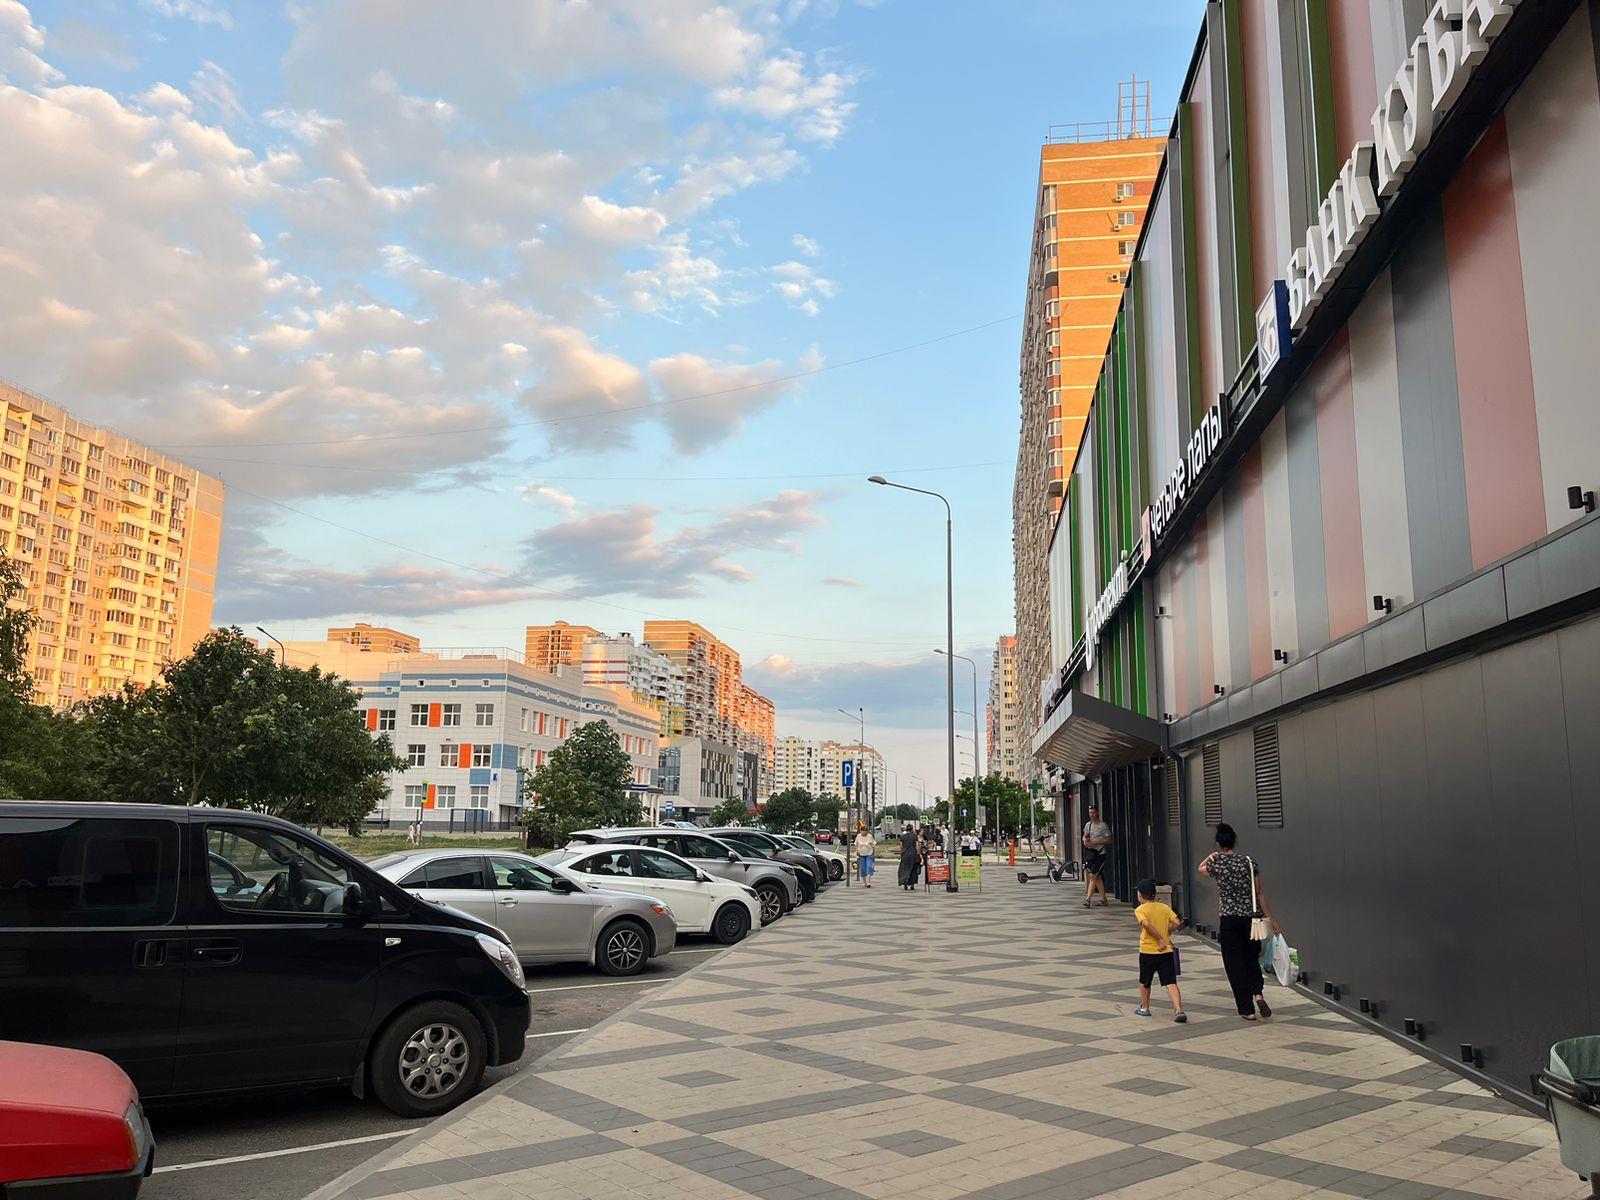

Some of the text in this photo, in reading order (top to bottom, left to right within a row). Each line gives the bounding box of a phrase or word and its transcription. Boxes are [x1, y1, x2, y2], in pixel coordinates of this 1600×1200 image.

[1287, 0, 1510, 330] БАНК КУБА
[1150, 393, 1223, 540] четыре лапы
